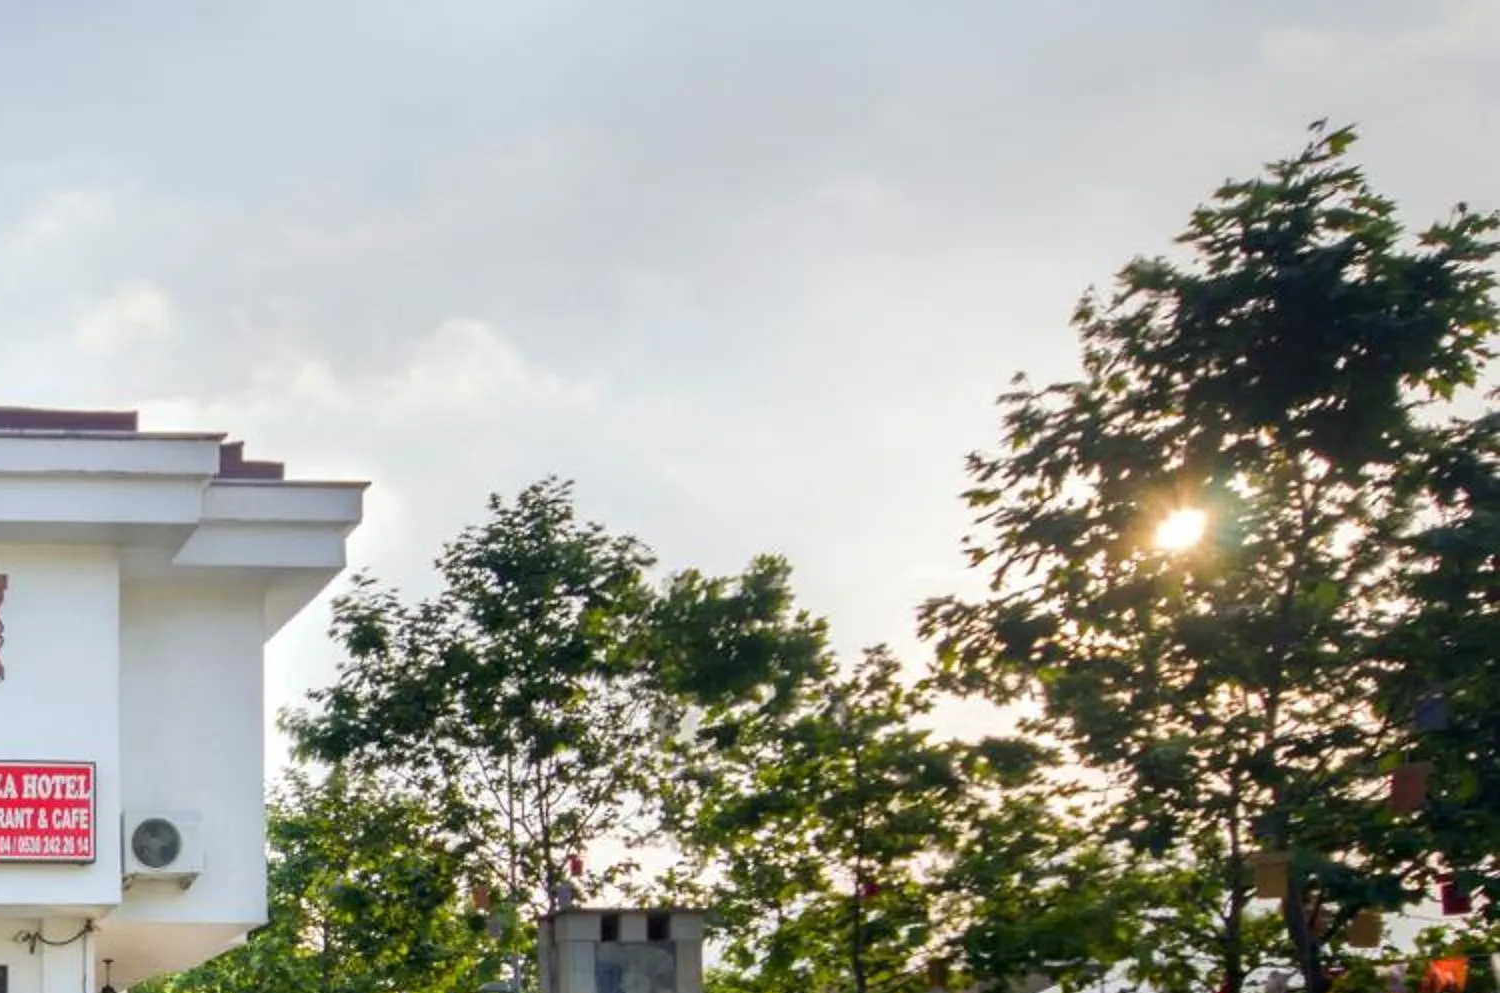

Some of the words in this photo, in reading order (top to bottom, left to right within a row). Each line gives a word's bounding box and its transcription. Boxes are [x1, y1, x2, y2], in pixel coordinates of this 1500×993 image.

[22, 774, 91, 799] HOTEL
[37, 807, 48, 829] &
[52, 808, 89, 829] CAFE
